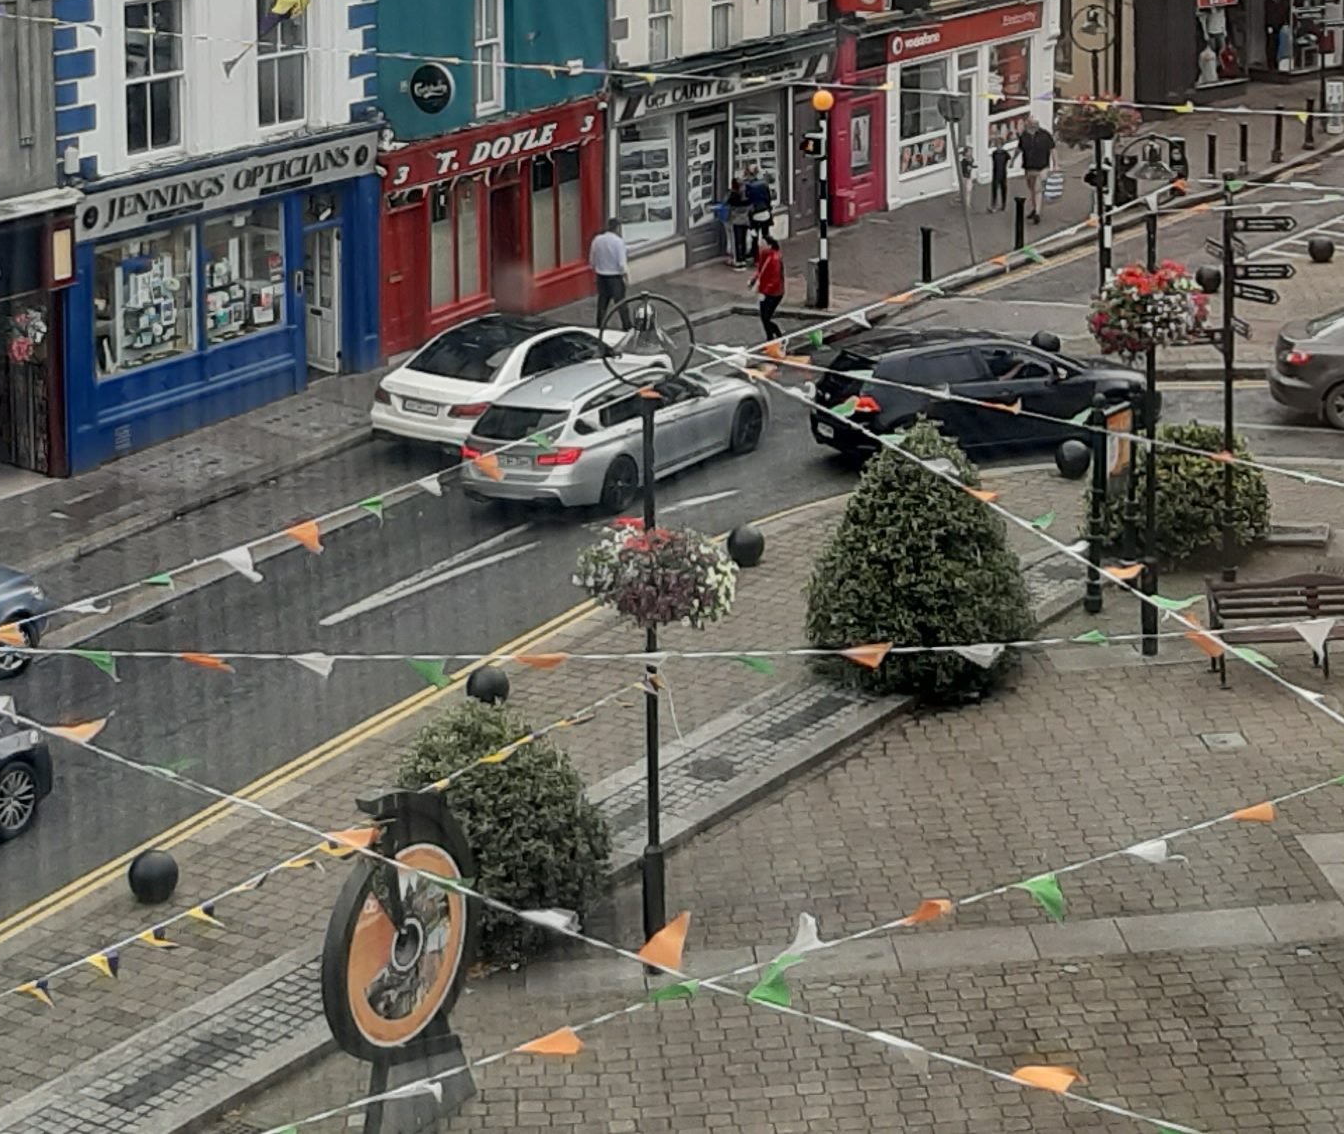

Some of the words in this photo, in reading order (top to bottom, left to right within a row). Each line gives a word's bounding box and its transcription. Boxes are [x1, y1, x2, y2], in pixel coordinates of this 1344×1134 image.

[104, 172, 225, 228] JENNINGS
[232, 145, 351, 192] OPTICIANS
[393, 166, 410, 185] 3
[436, 150, 459, 174] T.
[469, 122, 558, 166] DOYLE
